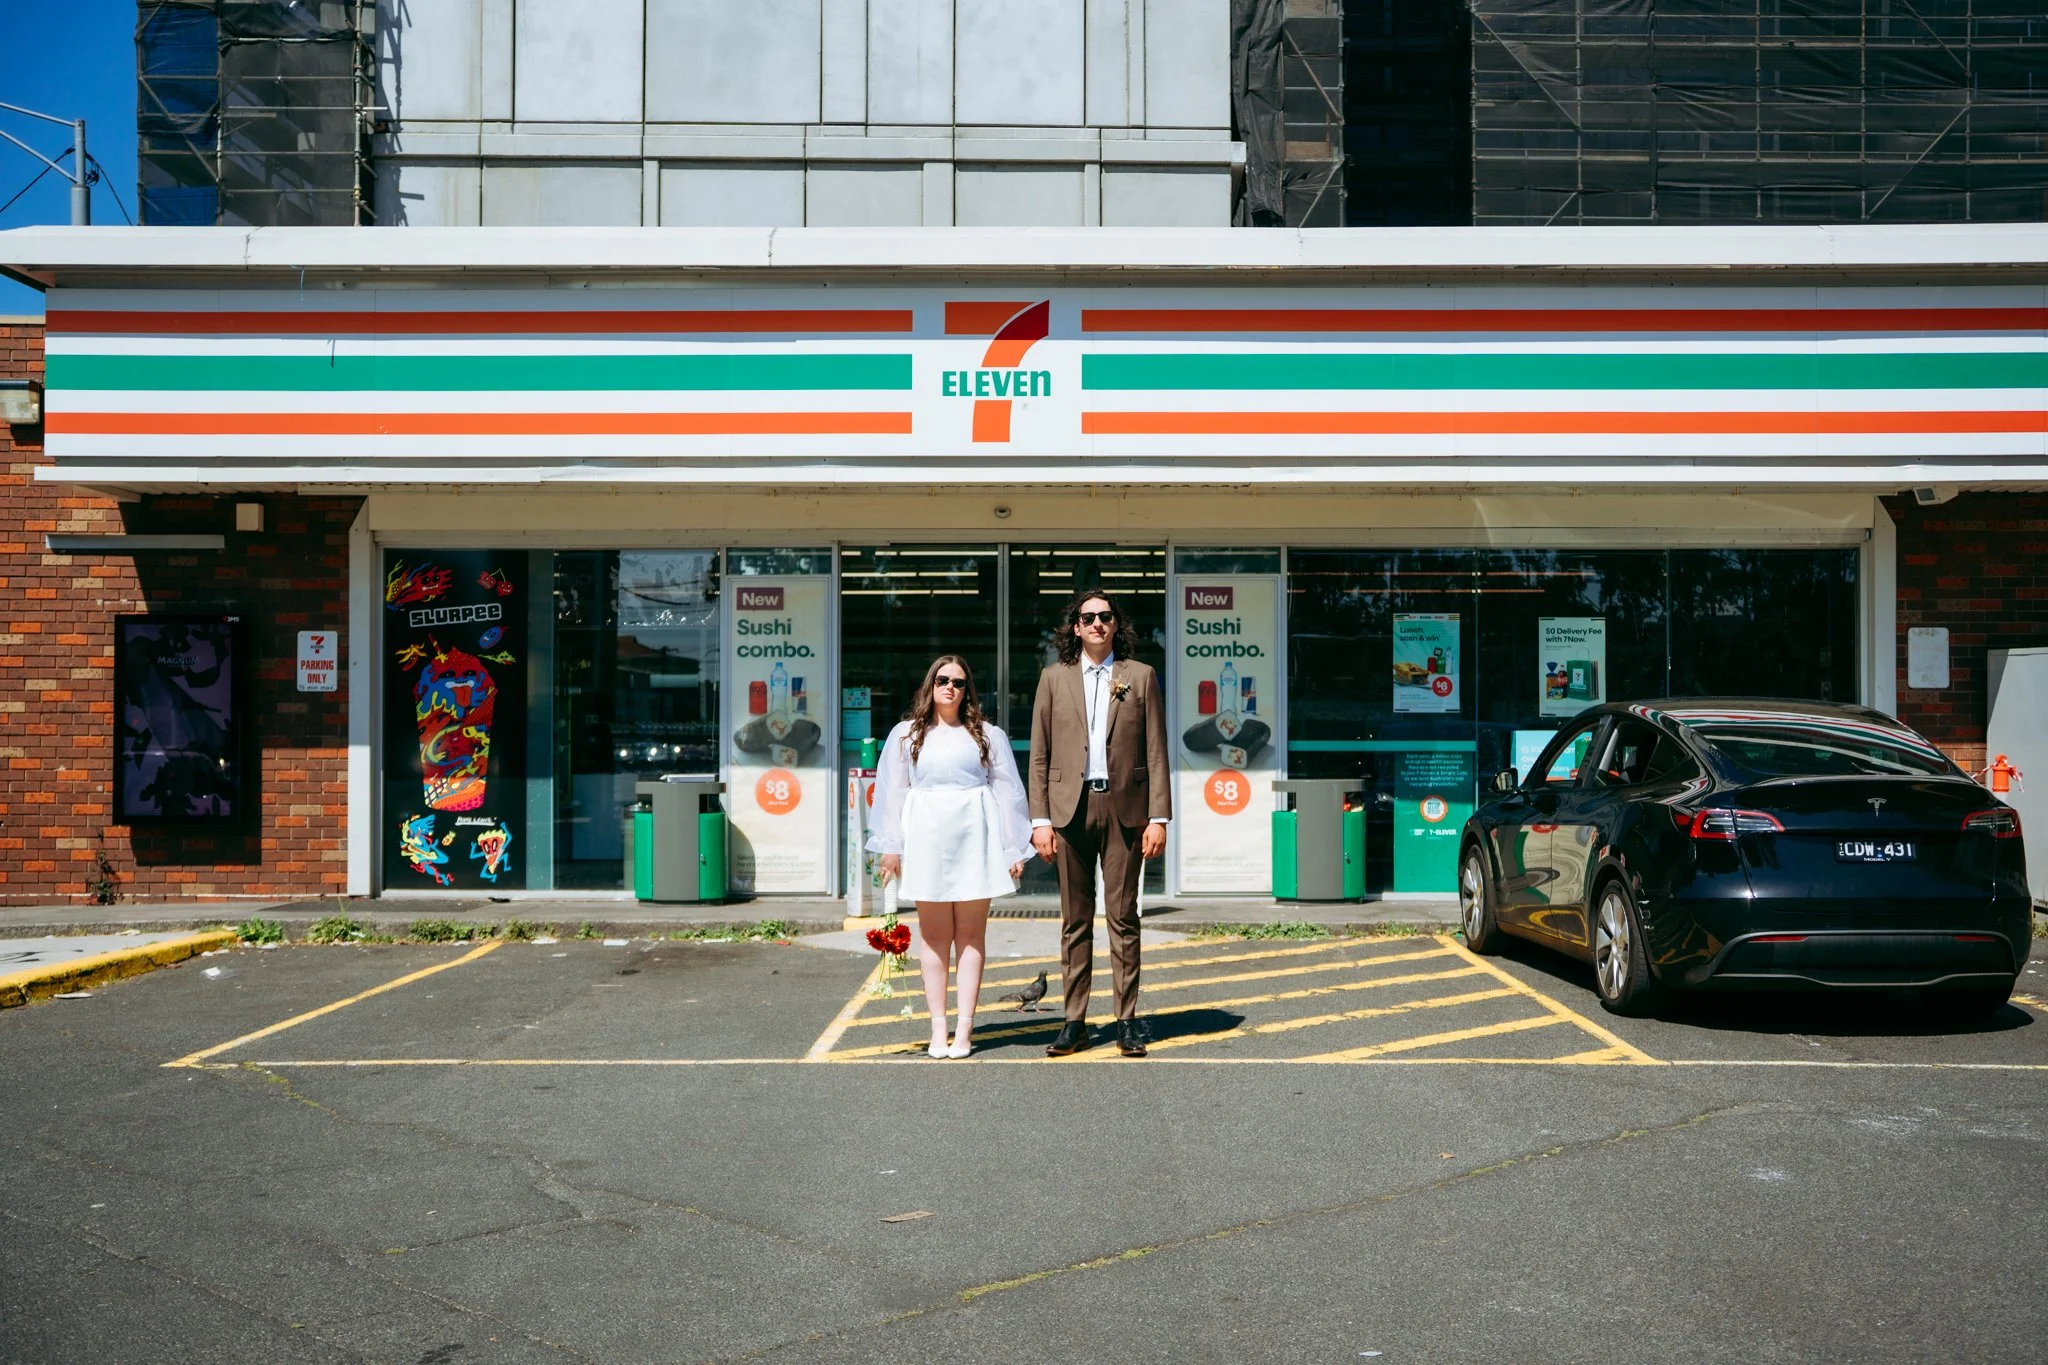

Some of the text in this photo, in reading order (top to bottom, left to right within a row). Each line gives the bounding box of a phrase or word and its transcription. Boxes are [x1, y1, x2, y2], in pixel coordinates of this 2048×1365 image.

[742, 592, 779, 606] New
[1191, 592, 1228, 606] New
[737, 618, 792, 635] Sushi
[1186, 618, 1241, 635] Sushi
[1545, 627, 1556, 635] $0
[1556, 627, 1587, 636] Delivery
[737, 641, 815, 657] combo.
[1186, 641, 1265, 657] combo.
[301, 660, 334, 670] PARKING
[307, 673, 327, 684] ONLY
[766, 780, 789, 801] $8
[1214, 780, 1239, 801] $8
[1884, 842, 1912, 856] 431
